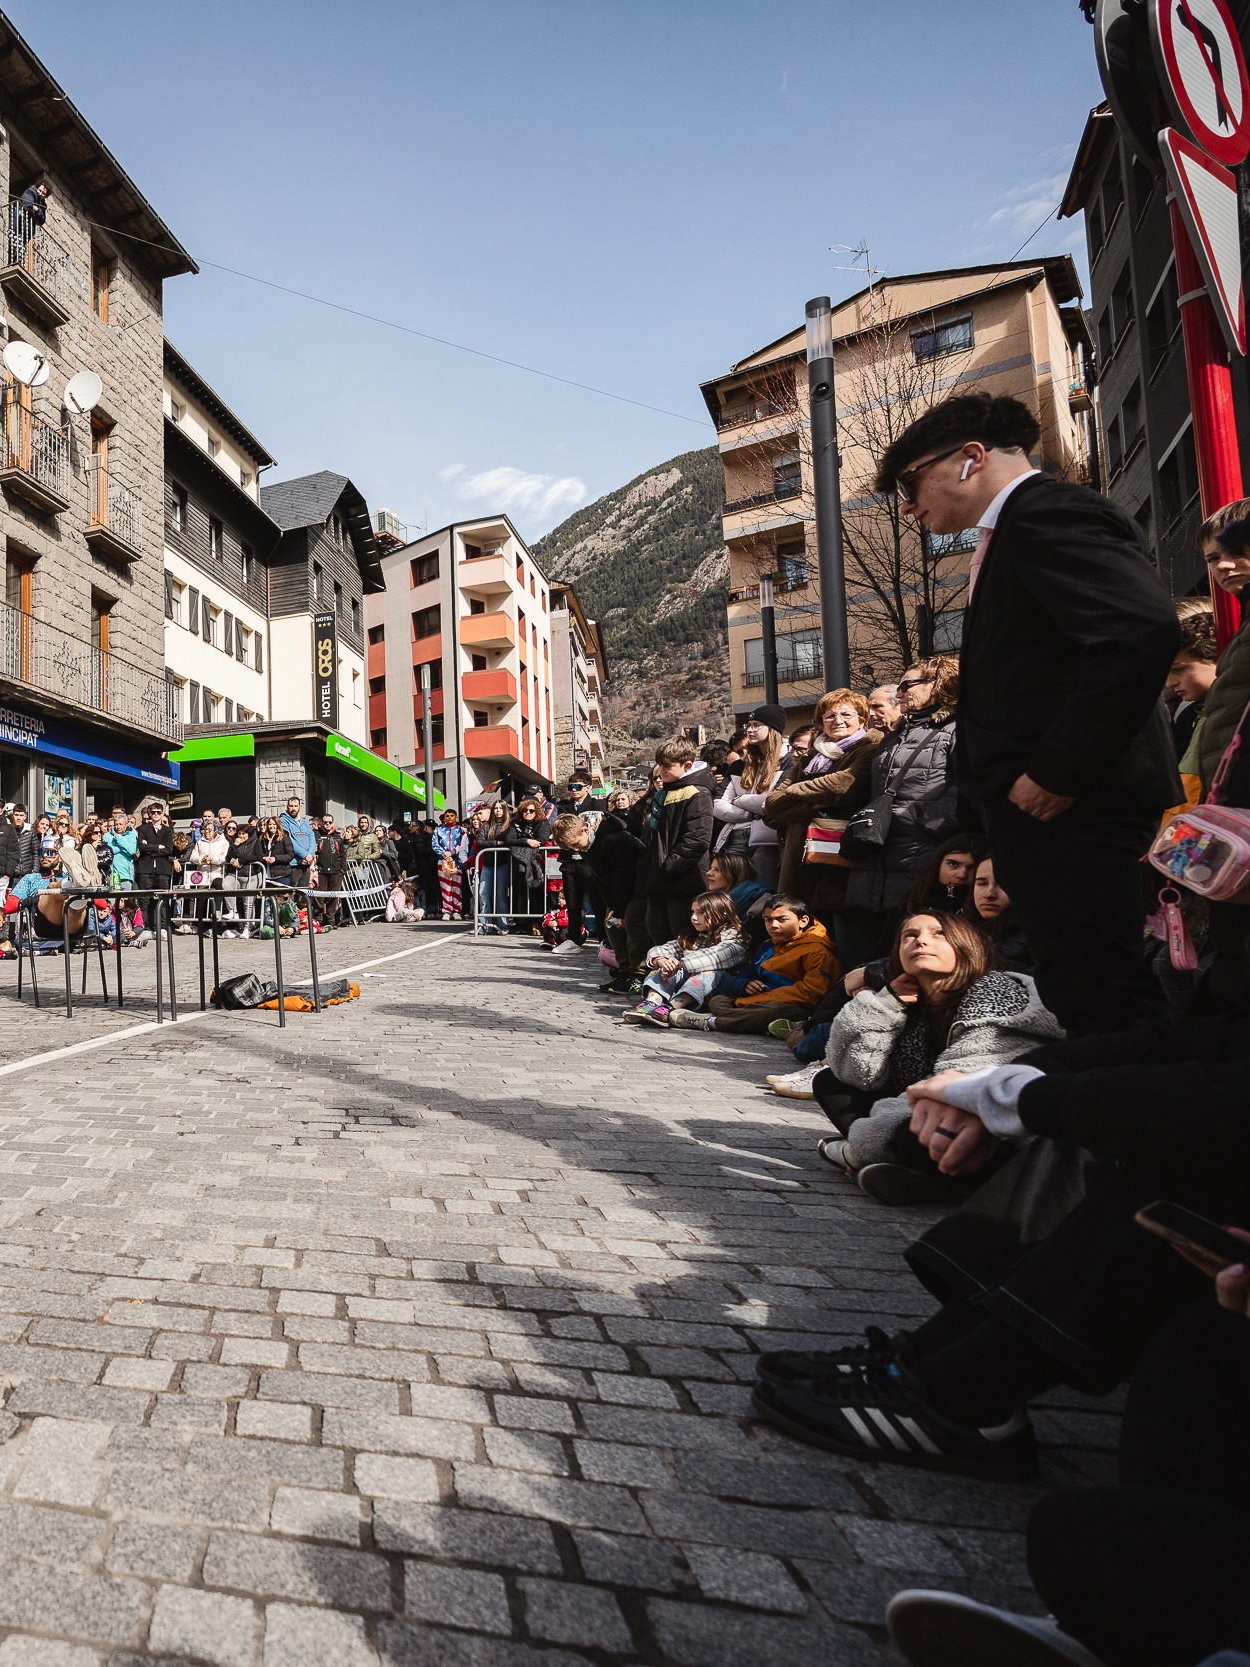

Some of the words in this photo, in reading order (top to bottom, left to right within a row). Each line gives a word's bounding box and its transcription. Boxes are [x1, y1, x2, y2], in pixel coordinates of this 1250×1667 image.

[315, 615, 333, 623] HOTEL
[317, 638, 333, 677] OROS
[321, 681, 331, 718] HOTEL
